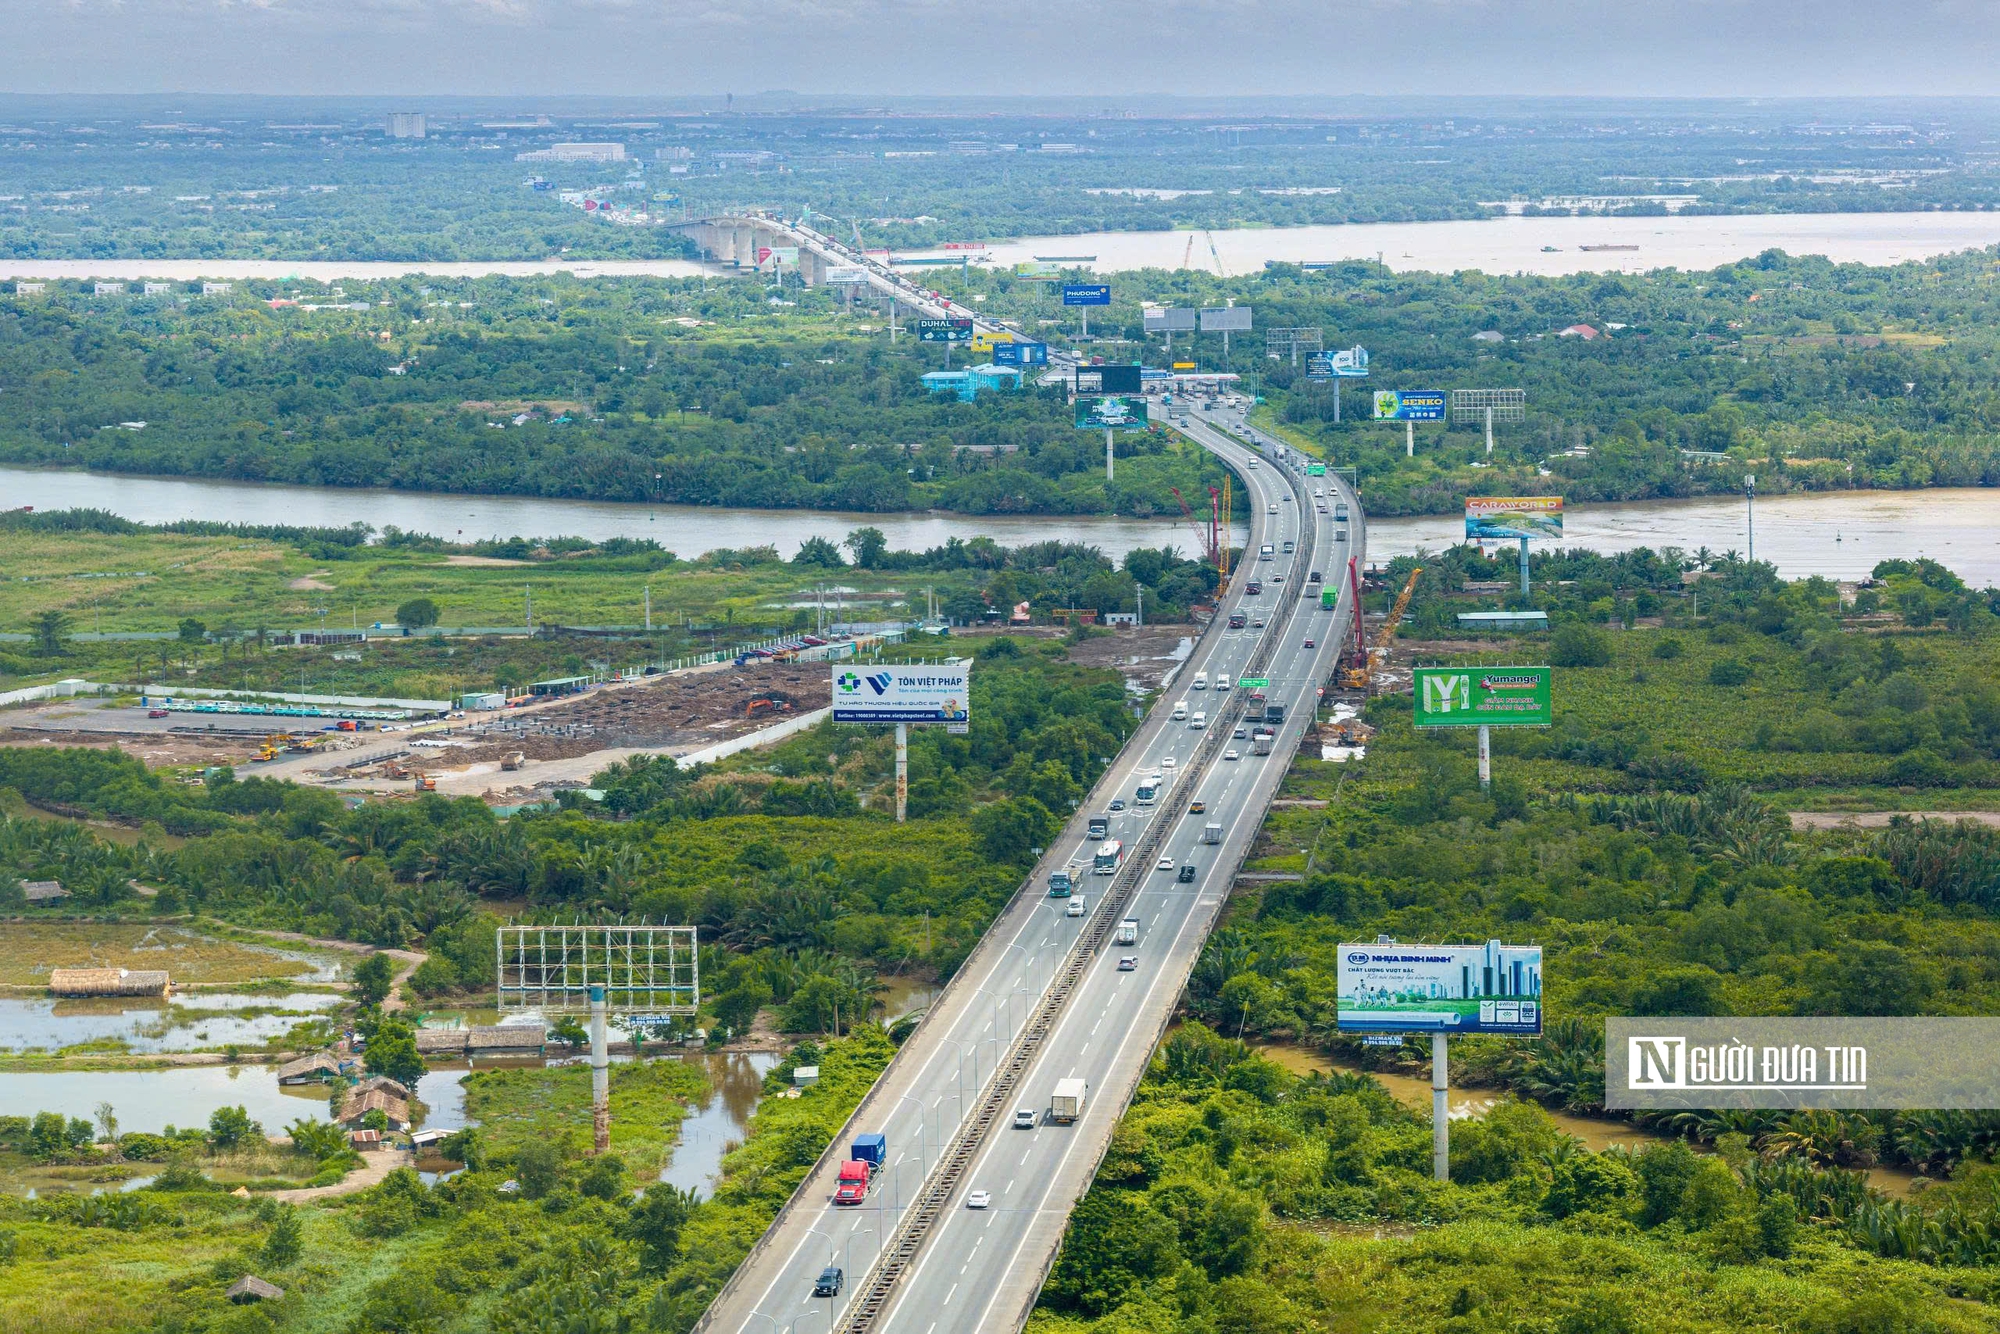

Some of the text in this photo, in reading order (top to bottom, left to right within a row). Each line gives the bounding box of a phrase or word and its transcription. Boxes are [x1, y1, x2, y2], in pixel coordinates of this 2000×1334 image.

[1402, 398, 1443, 406] SENKO
[898, 676, 962, 688] TÔN VIỆT PHÁP
[1485, 674, 1540, 684] Yumangel
[1372, 955, 1400, 964] NHỰA
